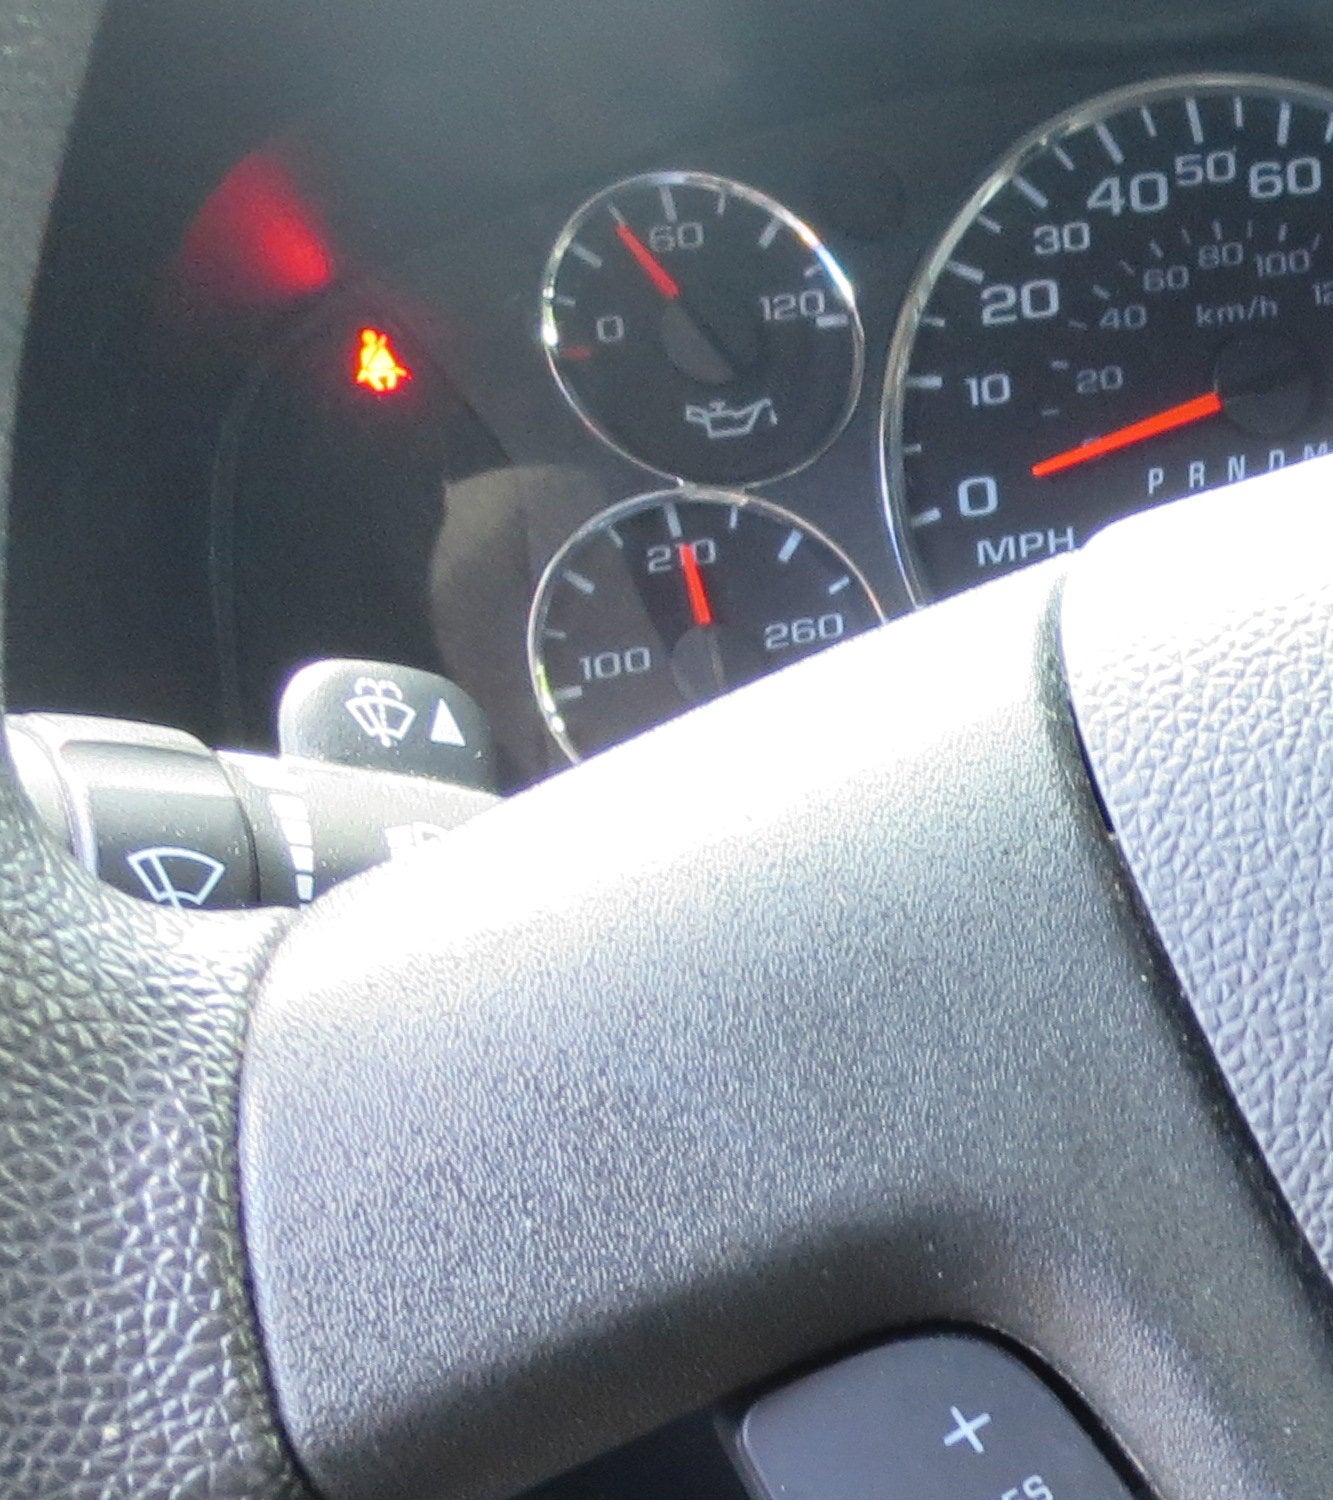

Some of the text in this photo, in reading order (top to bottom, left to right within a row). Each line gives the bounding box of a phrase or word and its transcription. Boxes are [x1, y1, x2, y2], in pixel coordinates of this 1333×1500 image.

[1174, 149, 1237, 187] 50
[1249, 156, 1322, 199] 60
[1086, 172, 1169, 216] 40
[648, 221, 704, 252] 60
[1033, 221, 1091, 256] 30
[1198, 242, 1243, 270] 80
[1255, 248, 1311, 277] 100
[1143, 265, 1190, 292] 60
[760, 290, 825, 321] 120
[980, 278, 1060, 326] 20
[1099, 304, 1147, 330] 40
[1195, 296, 1279, 328] km/h
[597, 315, 624, 343] 0
[964, 372, 1011, 406] 10
[1076, 364, 1124, 394] 20
[957, 475, 999, 518] 0
[646, 538, 716, 575] 20
[976, 526, 1076, 567] MPH
[763, 612, 844, 651] 260
[579, 647, 651, 681] 100
